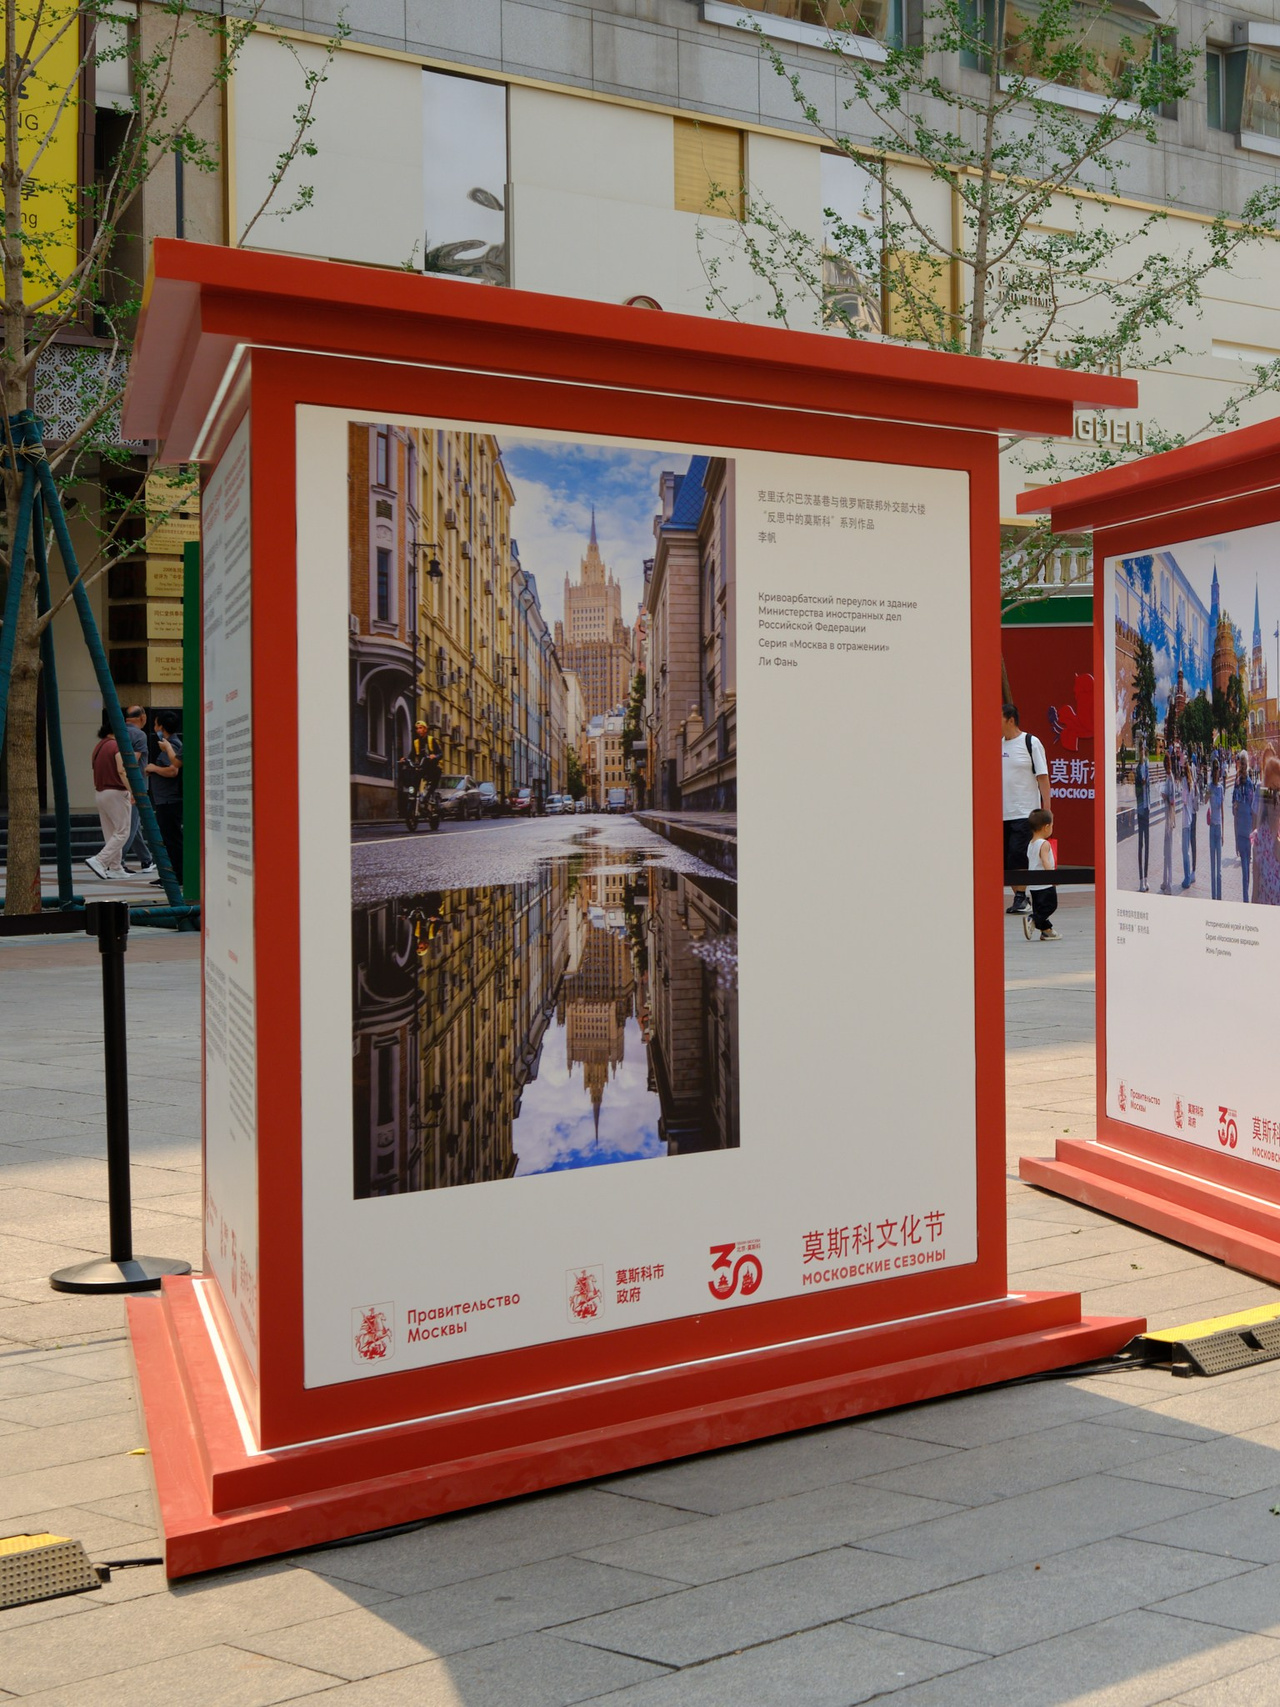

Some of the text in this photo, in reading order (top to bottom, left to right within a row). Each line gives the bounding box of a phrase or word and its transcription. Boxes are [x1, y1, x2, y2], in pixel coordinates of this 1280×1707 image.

[758, 490, 926, 515] 克里沃尔巴茨基巷与俄罗斯联邦外交部大楼
[758, 531, 776, 544] 李帆
[758, 592, 834, 605] Кривоарбатский
[836, 597, 878, 608] переулок
[887, 600, 918, 610] здание
[758, 606, 902, 622] Министерства иностранных дел
[758, 620, 866, 634] Российской Федерации
[758, 639, 787, 650] Серия
[790, 640, 827, 650] «Москва
[836, 643, 890, 653] отражении»
[758, 657, 798, 667] Ли Фань
[1130, 1088, 1160, 1106] Правительство
[1130, 1102, 1146, 1113] Москвы
[802, 1210, 946, 1264] 莫斯科文化节
[616, 1264, 665, 1286] 莫斯科市
[708, 1243, 762, 1300] 30
[802, 1249, 946, 1286] МОСКОВСКИЕ СЕЗОНЫ
[616, 1287, 641, 1304] 政府
[408, 1293, 520, 1325] Правительство
[408, 1322, 468, 1343] Москвы
